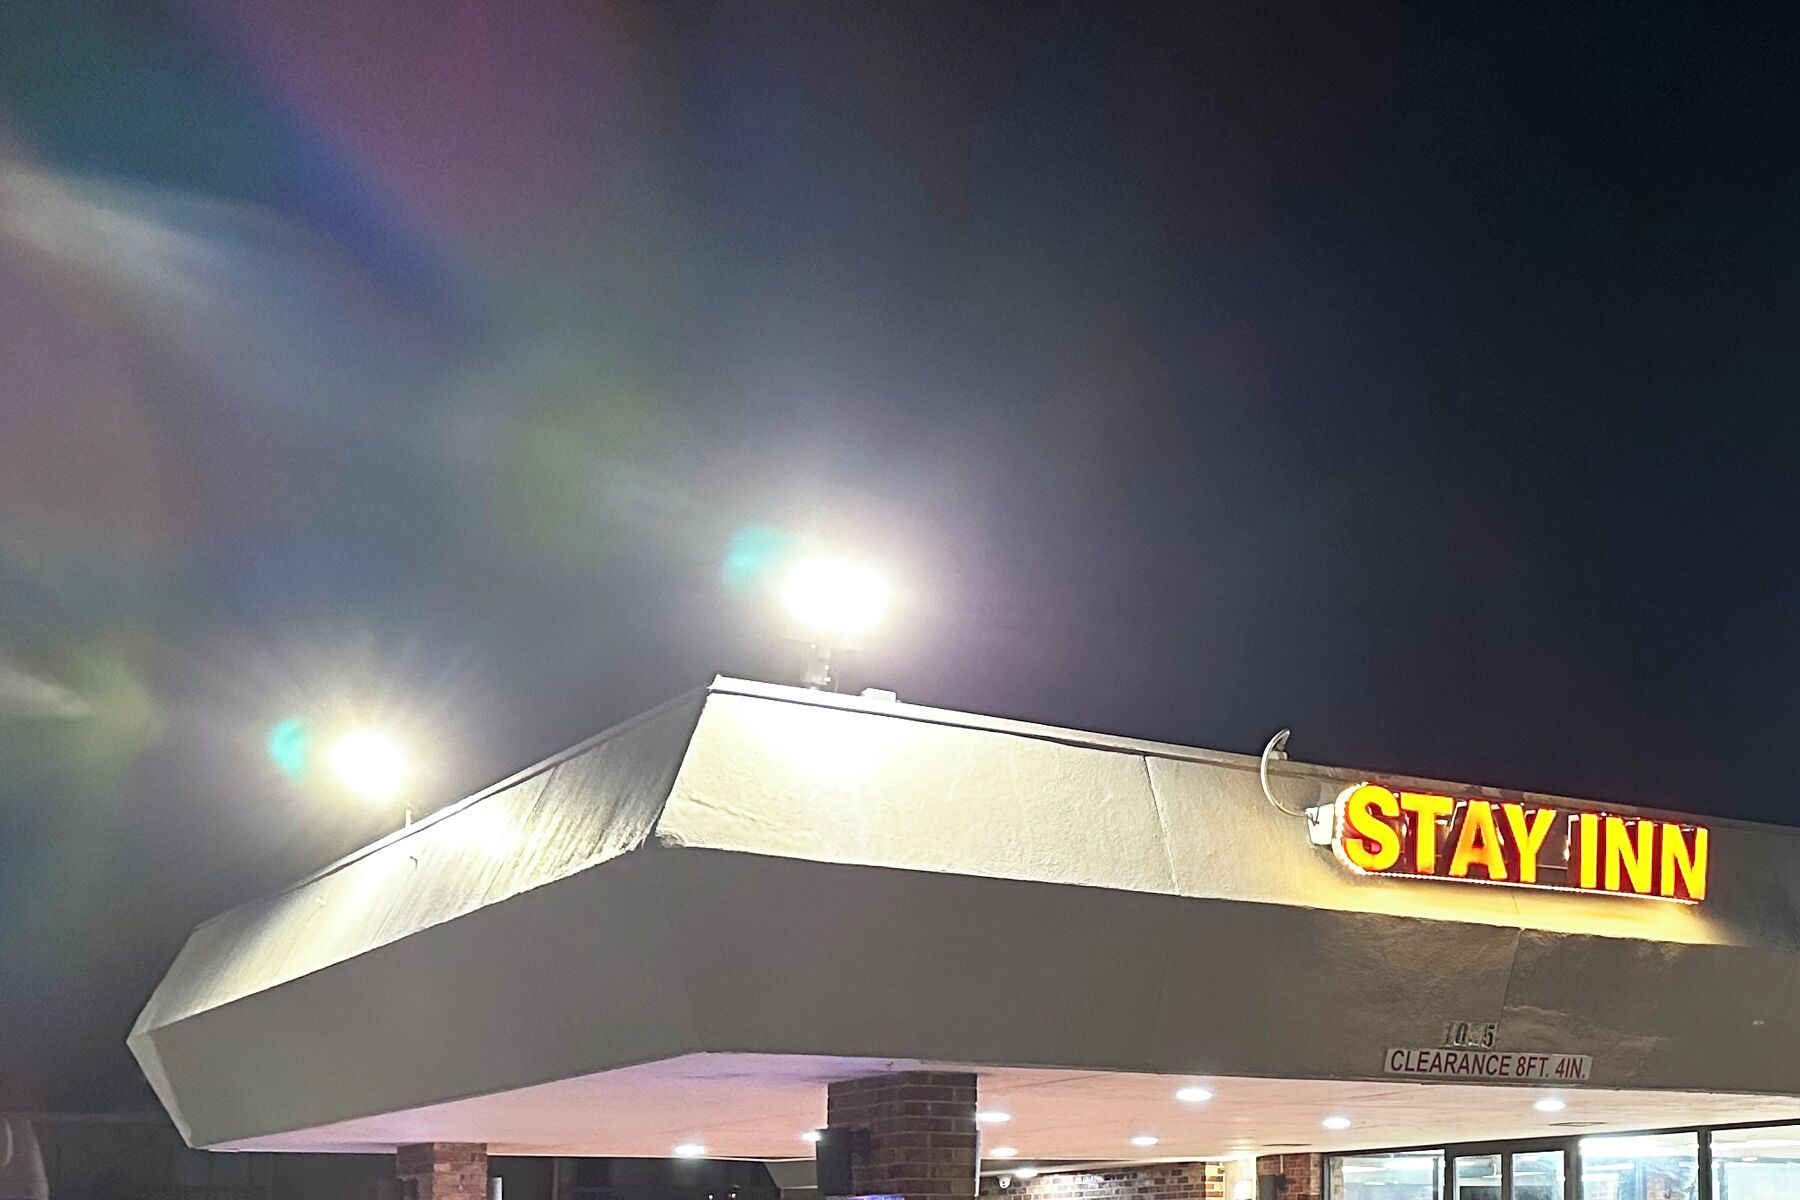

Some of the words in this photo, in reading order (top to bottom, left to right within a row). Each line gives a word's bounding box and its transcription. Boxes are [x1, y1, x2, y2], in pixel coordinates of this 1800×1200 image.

[1342, 783, 1557, 883] STAY
[1579, 812, 1710, 901] INN
[1391, 1050, 1512, 1076] CLEARANCE
[1515, 1056, 1550, 1078] 8FT.
[1555, 1057, 1586, 1079] 4IN.
